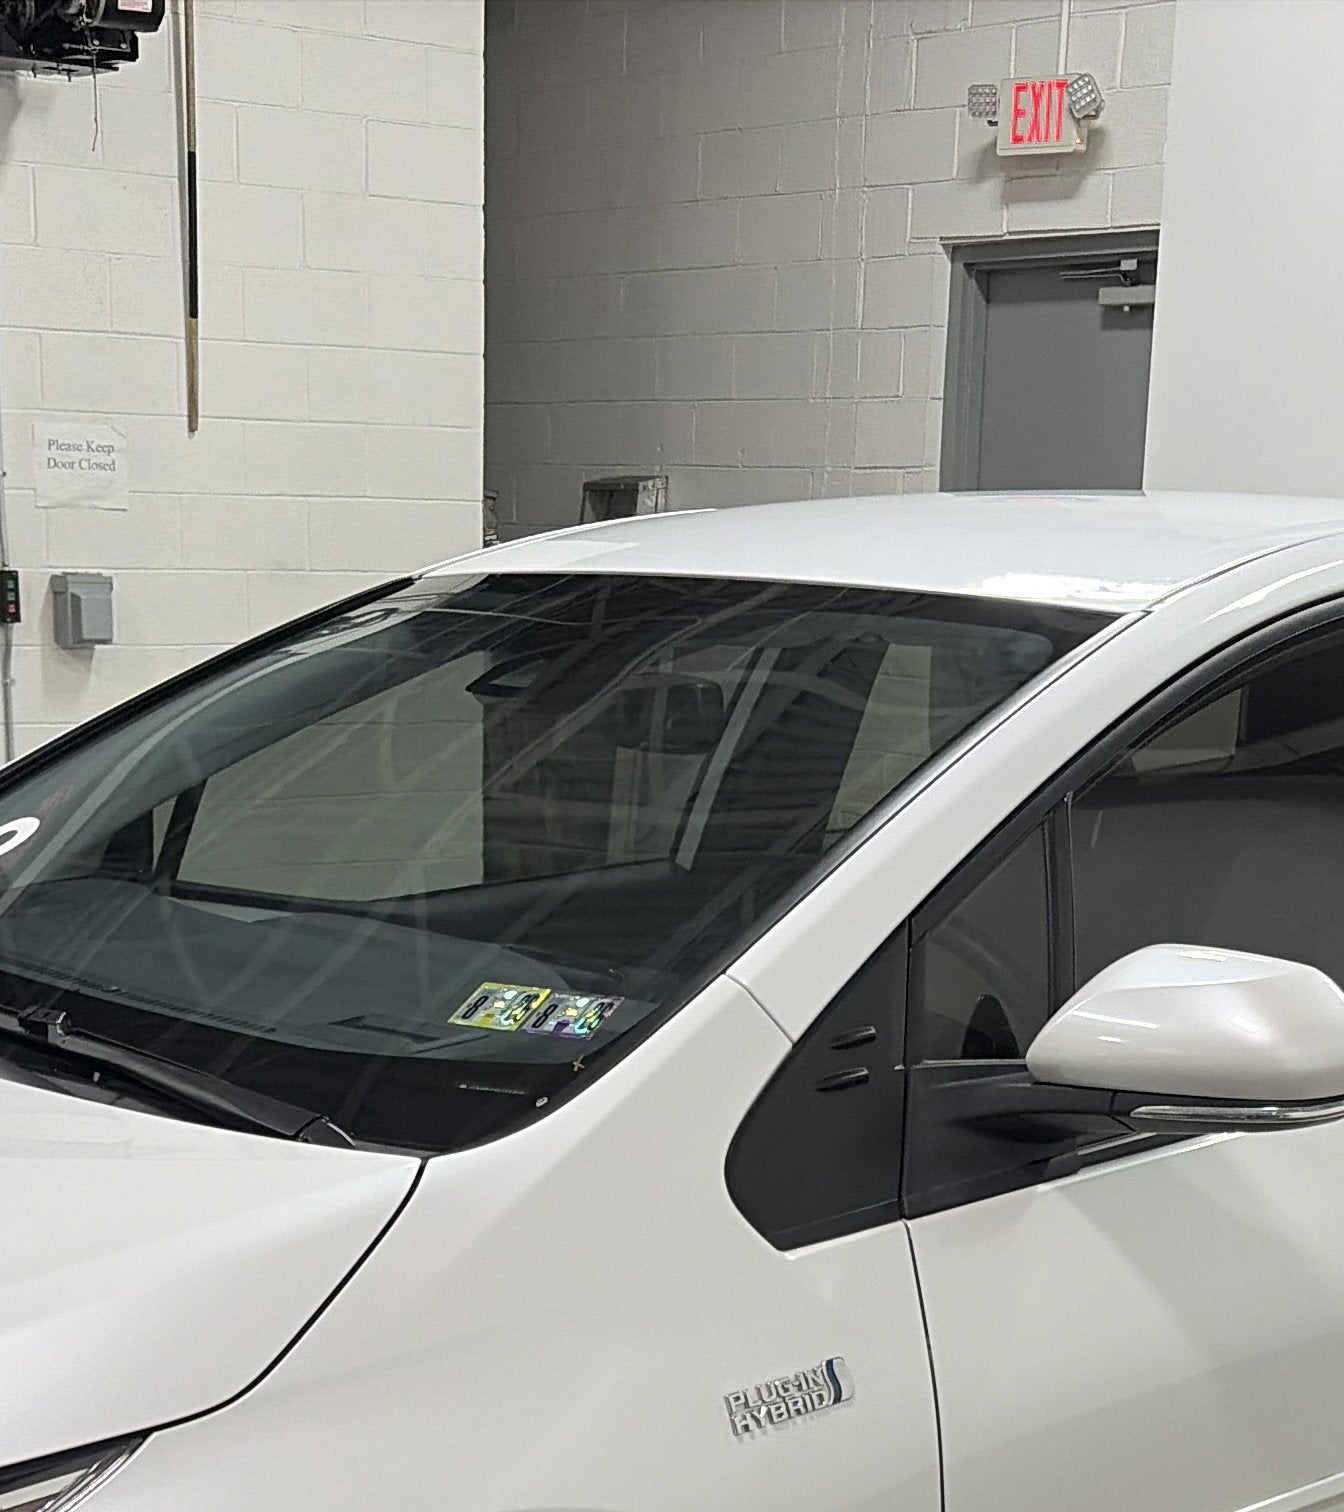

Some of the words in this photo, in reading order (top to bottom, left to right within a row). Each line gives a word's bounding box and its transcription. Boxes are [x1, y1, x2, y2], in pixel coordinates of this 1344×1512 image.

[1010, 79, 1069, 144] EXIT
[47, 439, 83, 453] Please
[86, 440, 115, 456] Keep
[47, 457, 76, 470] Door
[78, 458, 116, 472] Closed
[730, 1390, 827, 1437] HYBRID
